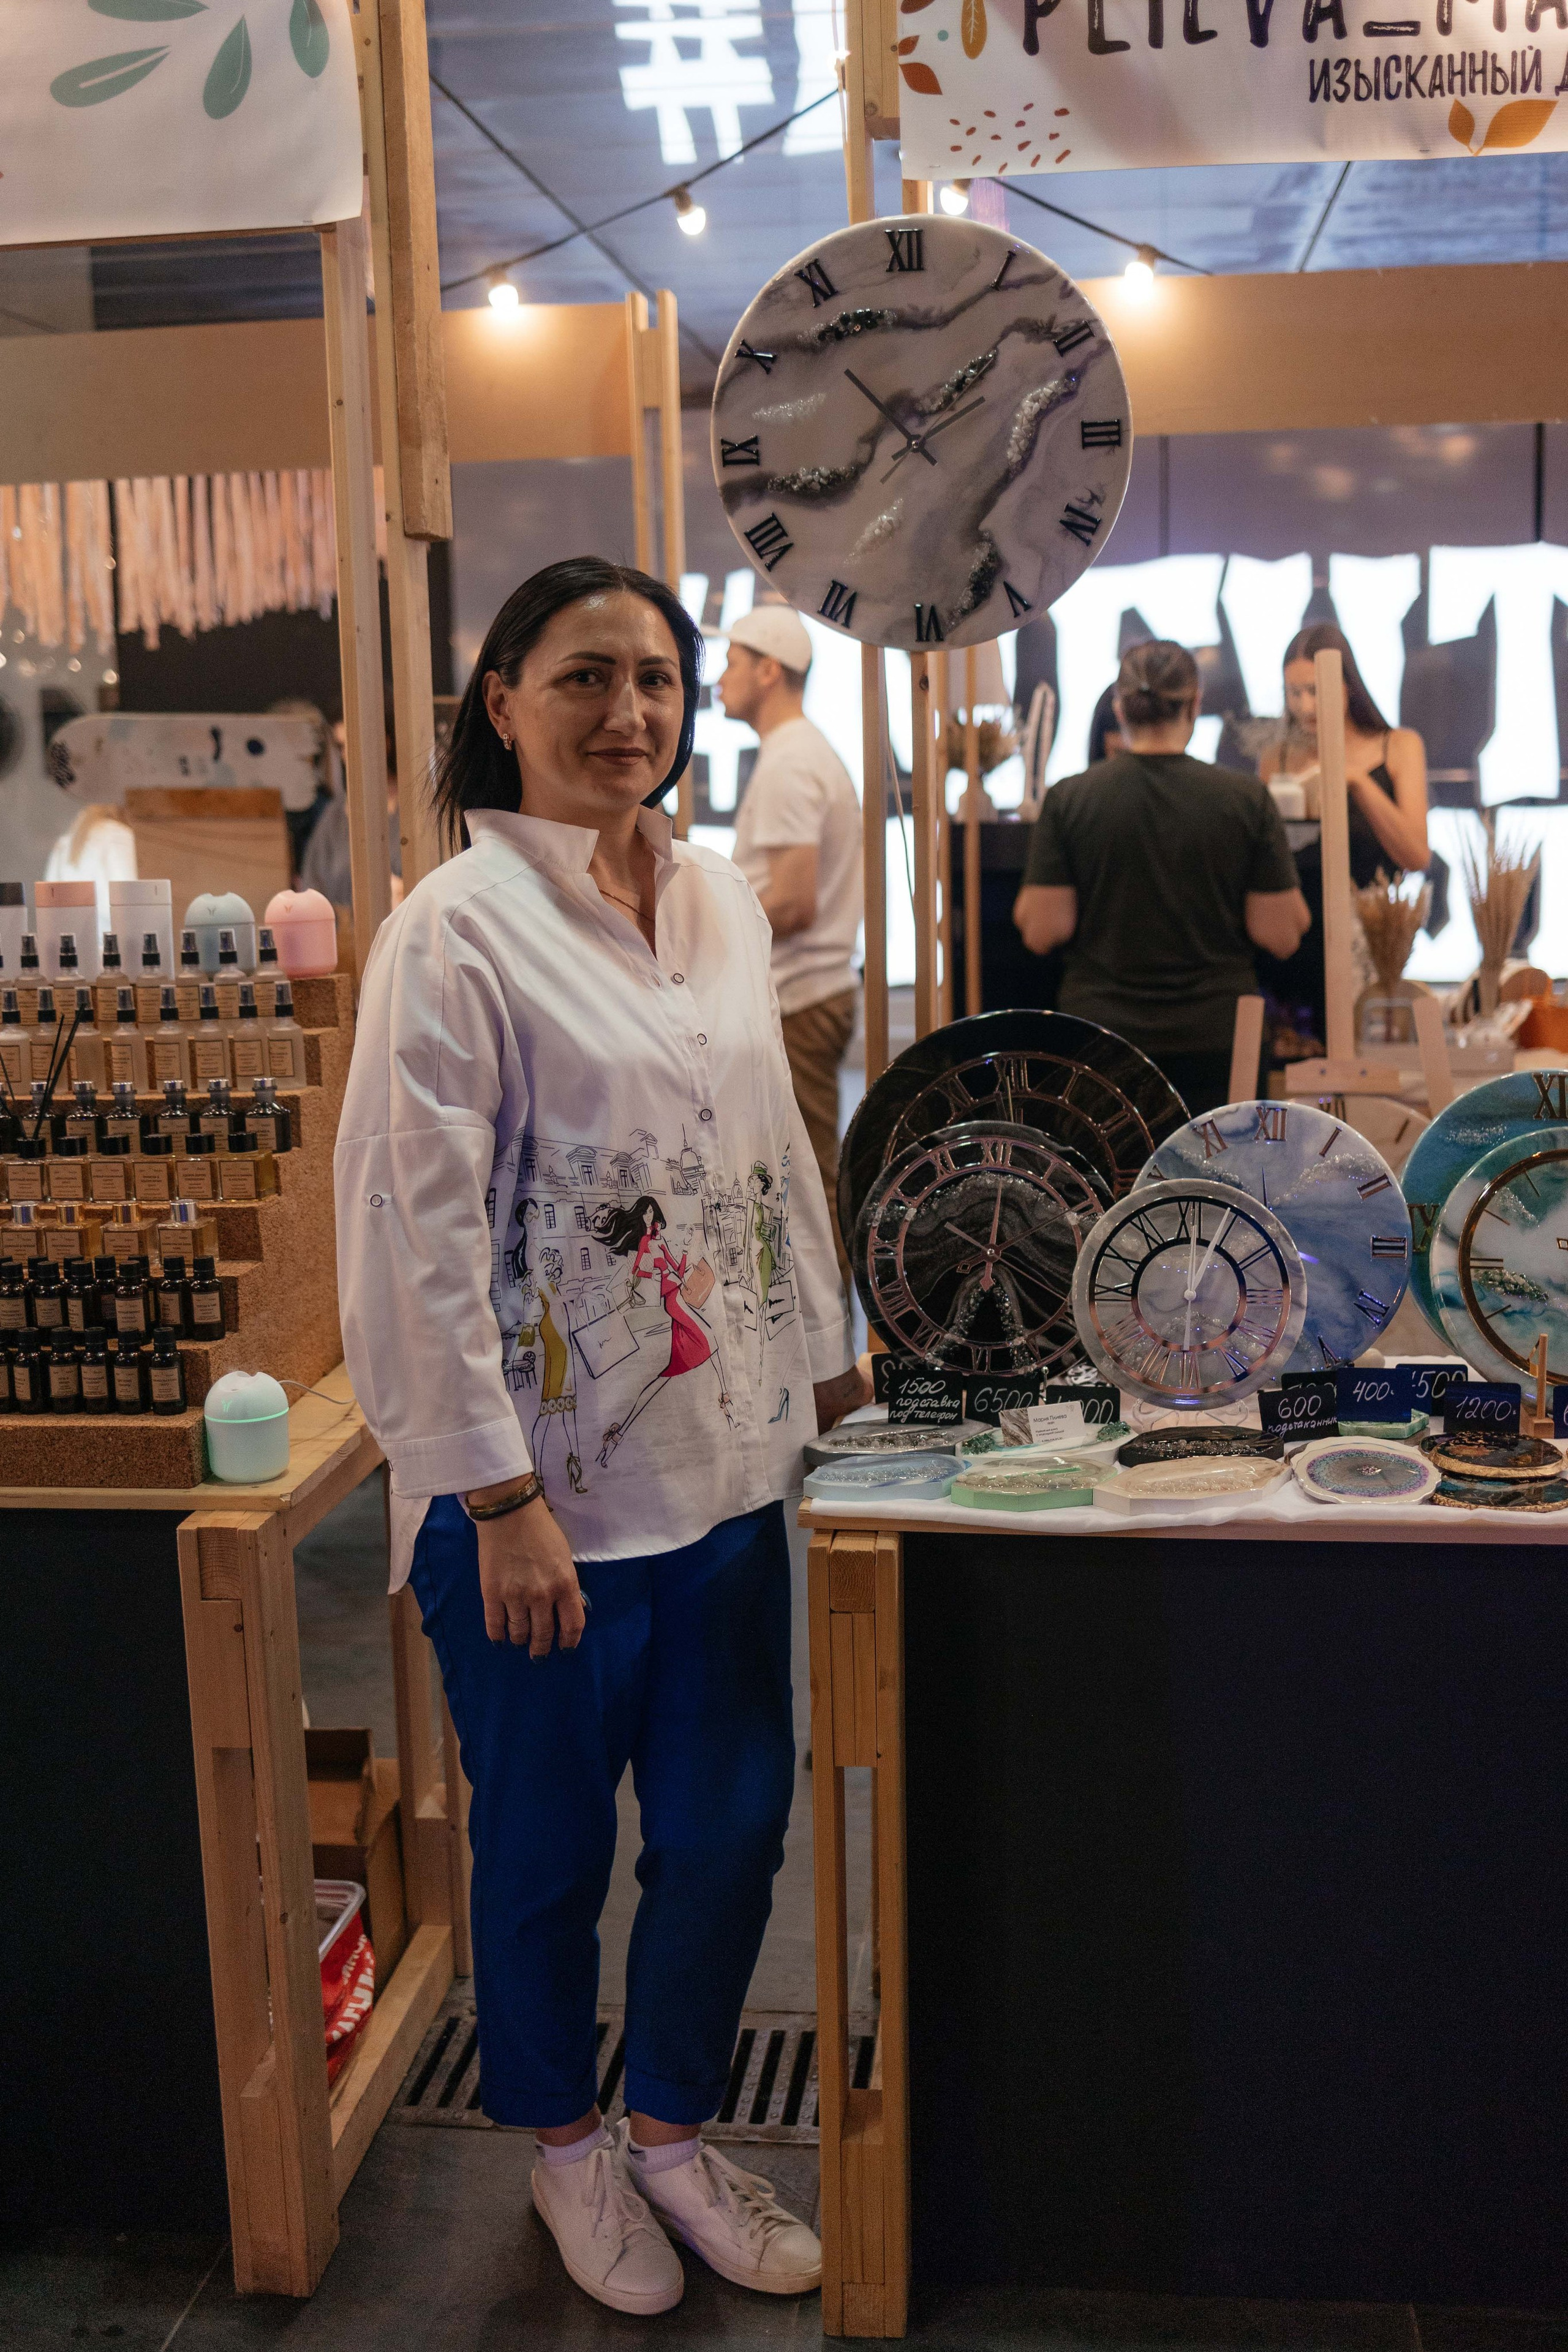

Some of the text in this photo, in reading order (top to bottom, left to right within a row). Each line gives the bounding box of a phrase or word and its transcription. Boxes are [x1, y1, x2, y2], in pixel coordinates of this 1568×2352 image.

[1308, 45, 1542, 103] ИЗЫСКАННЫЙ
[885, 228, 925, 272] XII
[794, 258, 838, 307] XI
[991, 251, 1016, 291] I
[1053, 320, 1095, 356] II
[735, 339, 777, 374] X
[721, 435, 760, 467] IX
[1080, 418, 1121, 450] III
[744, 512, 794, 571] VIII
[1059, 503, 1102, 546] IV
[817, 579, 858, 628] VII
[1003, 580, 1031, 618] V
[914, 604, 944, 643] VI
[1192, 1118, 1227, 1159] XI
[1254, 1106, 1289, 1141] XII
[899, 1378, 946, 1395] 1500
[974, 1387, 1033, 1412] 6500
[1411, 1370, 1467, 1399] 50
[889, 1409, 958, 1423] под телефон
[895, 1395, 960, 1413] подставка
[1058, 1395, 1114, 1425] 00
[1278, 1395, 1322, 1419] 600
